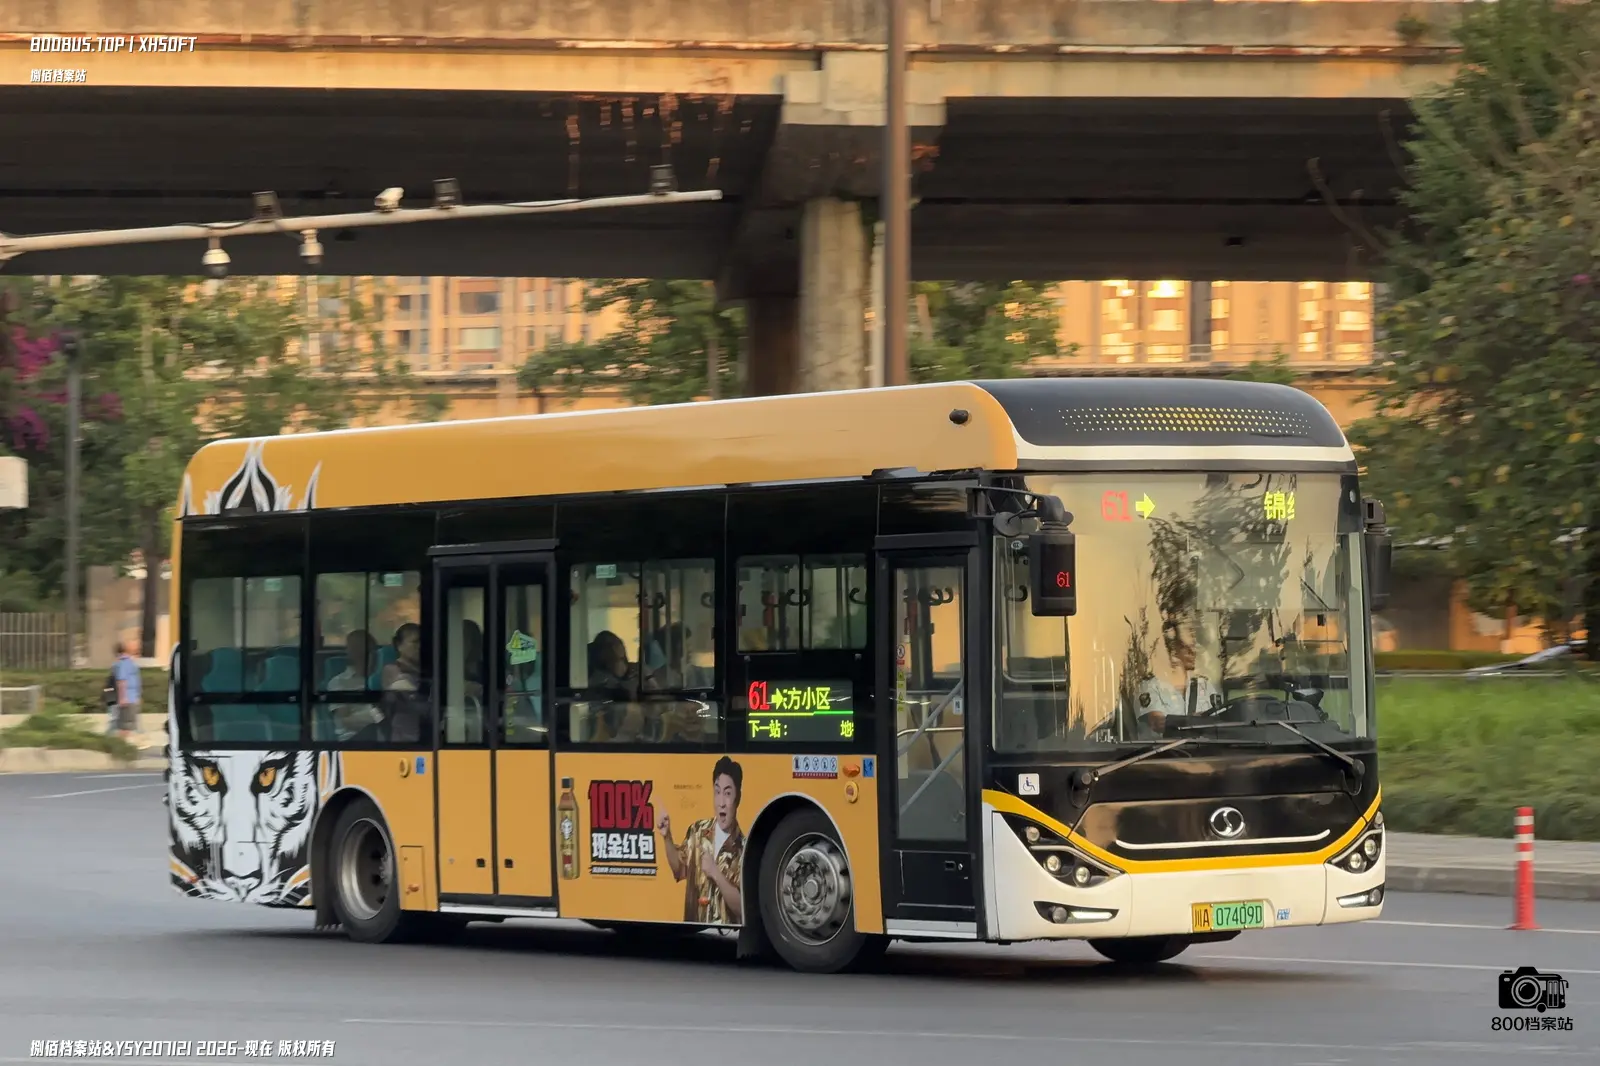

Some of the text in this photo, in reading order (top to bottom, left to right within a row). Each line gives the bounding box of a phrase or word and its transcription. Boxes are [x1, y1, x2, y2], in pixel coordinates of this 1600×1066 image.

[1101, 490, 1132, 522] 61
[1056, 571, 1071, 588] 61
[748, 681, 770, 710] 61
[588, 780, 654, 829] 100%
[592, 832, 655, 860] 现金红包
